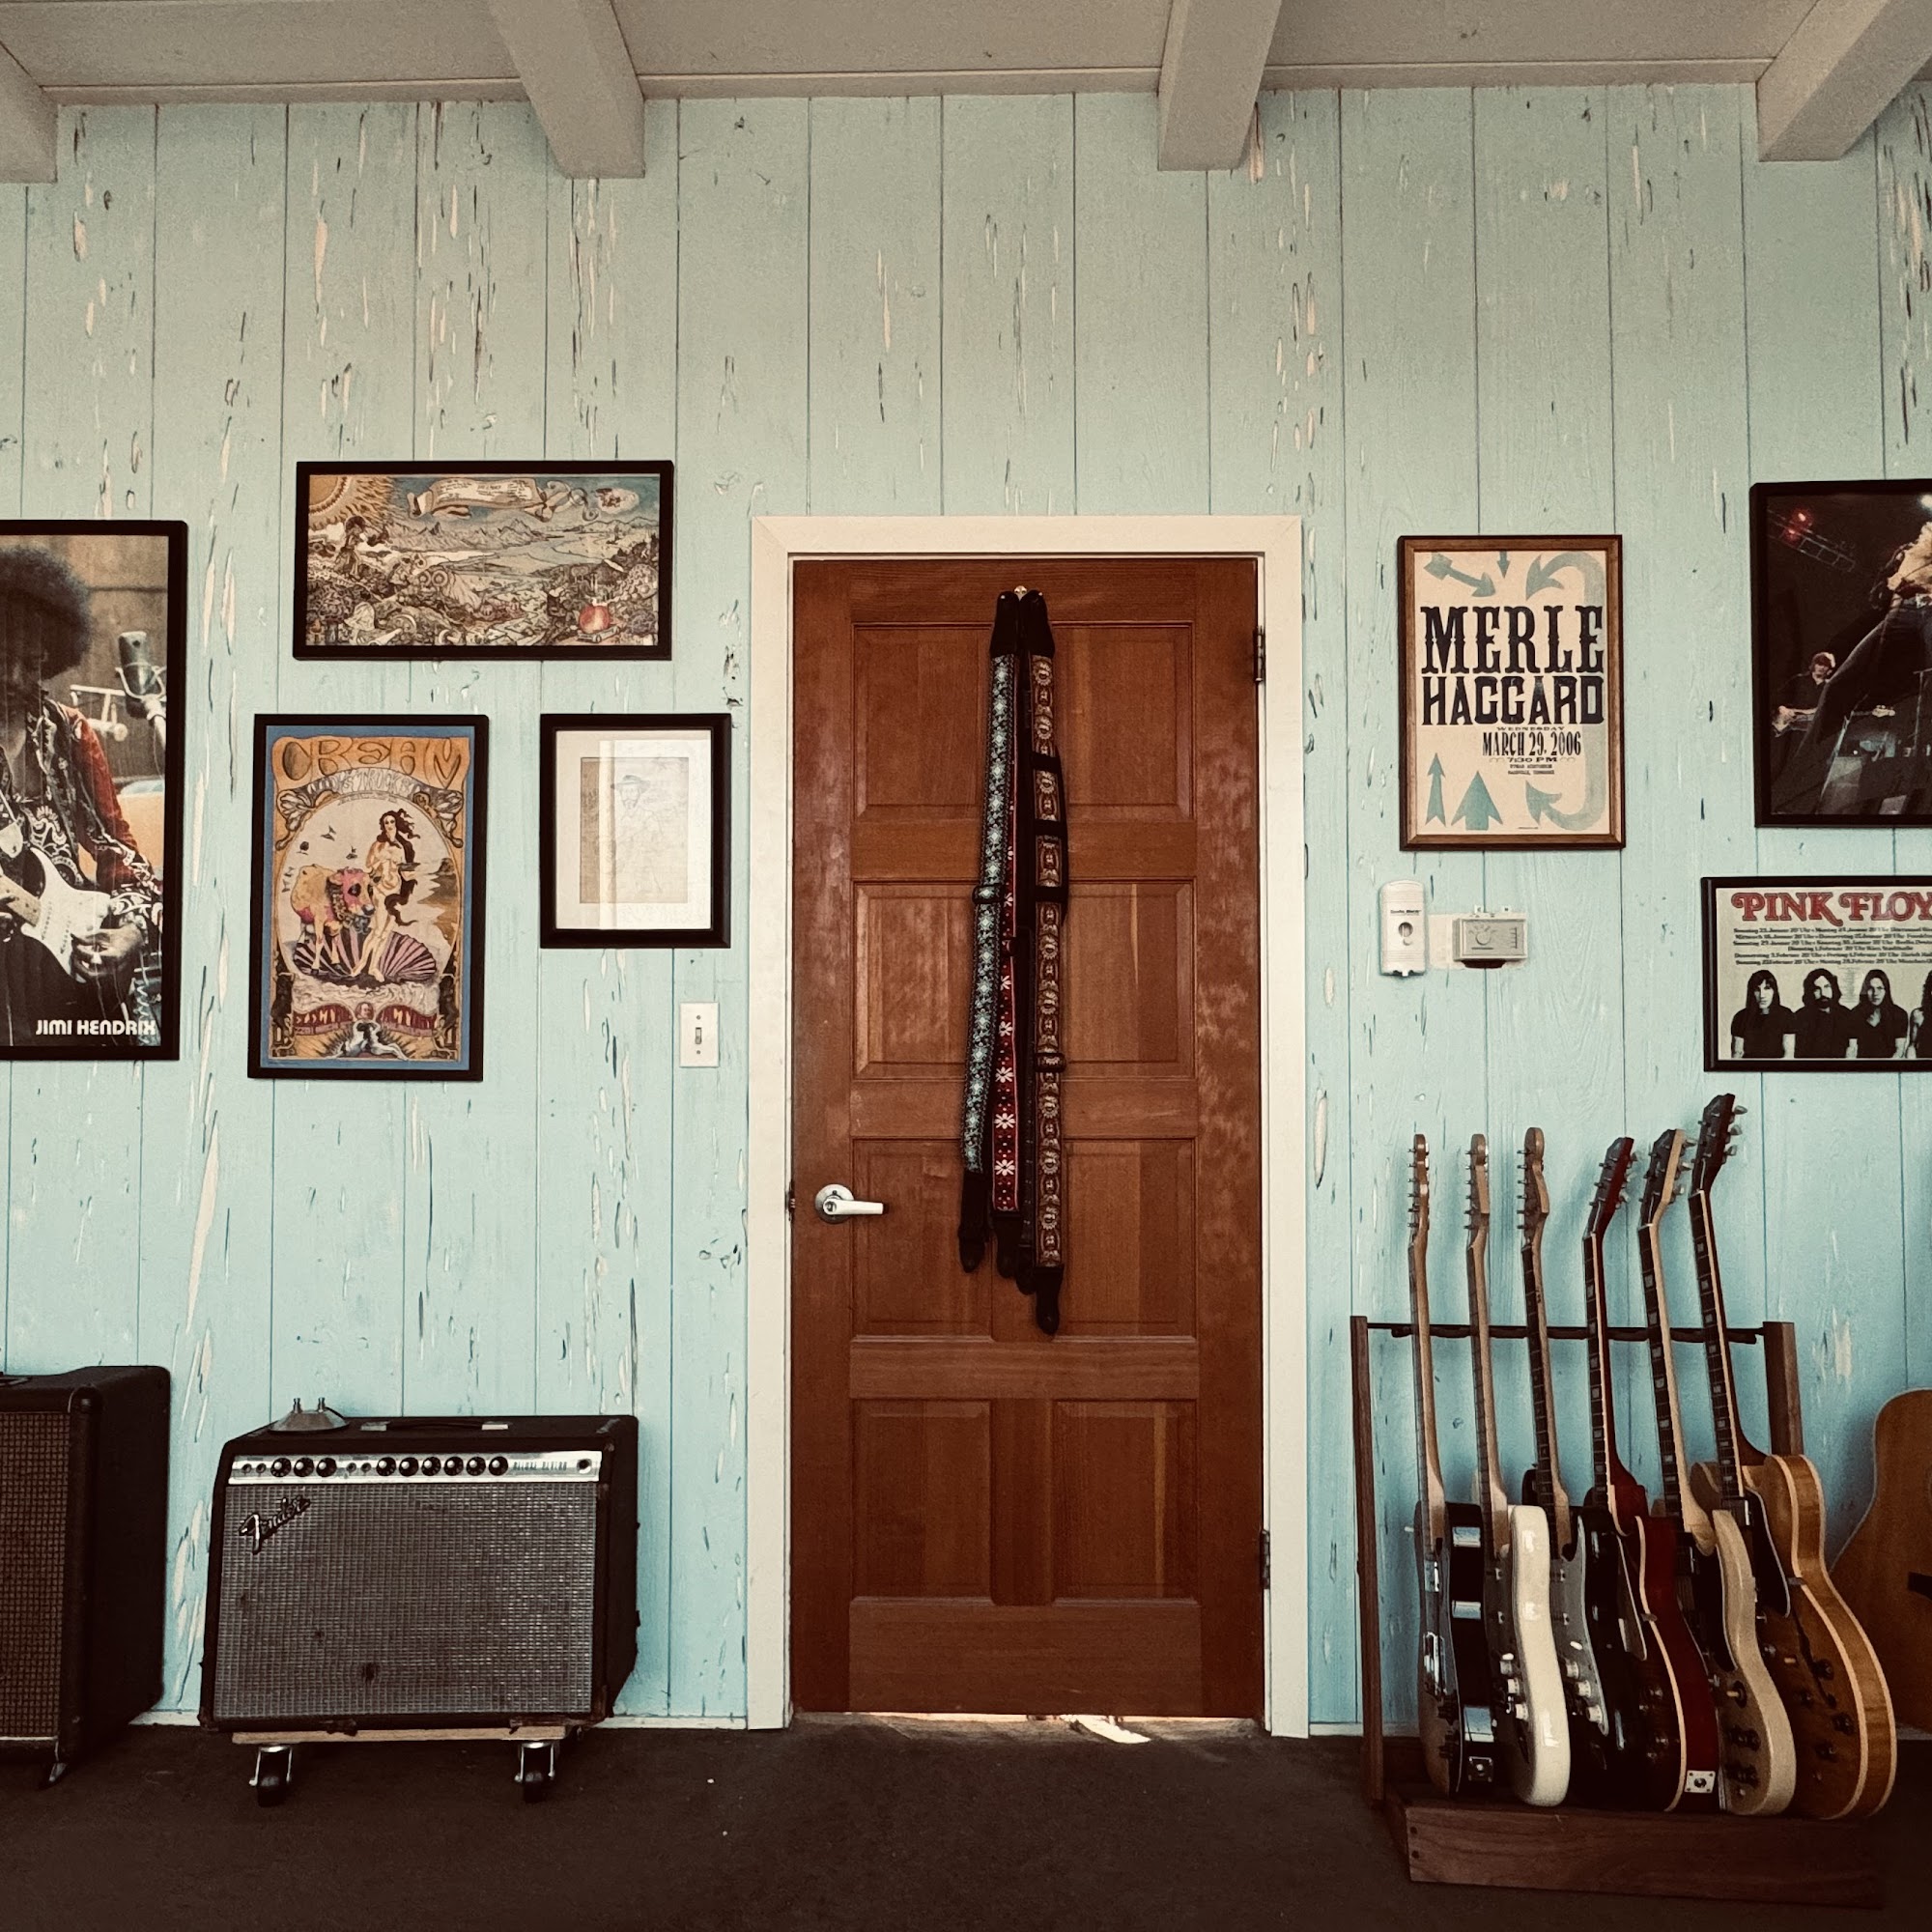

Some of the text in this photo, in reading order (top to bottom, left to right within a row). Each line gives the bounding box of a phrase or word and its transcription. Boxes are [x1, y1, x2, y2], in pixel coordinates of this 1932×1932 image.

[1420, 606, 1605, 673] MERLE
[1422, 675, 1605, 725] HAGGARD
[271, 736, 469, 790] CREAM
[1483, 731, 1524, 756] MARCH
[1550, 731, 1581, 755] 2006
[1731, 892, 1844, 927] PINK
[35, 1019, 156, 1036] JIMI HENDRIX
[239, 1497, 311, 1555] Fender
